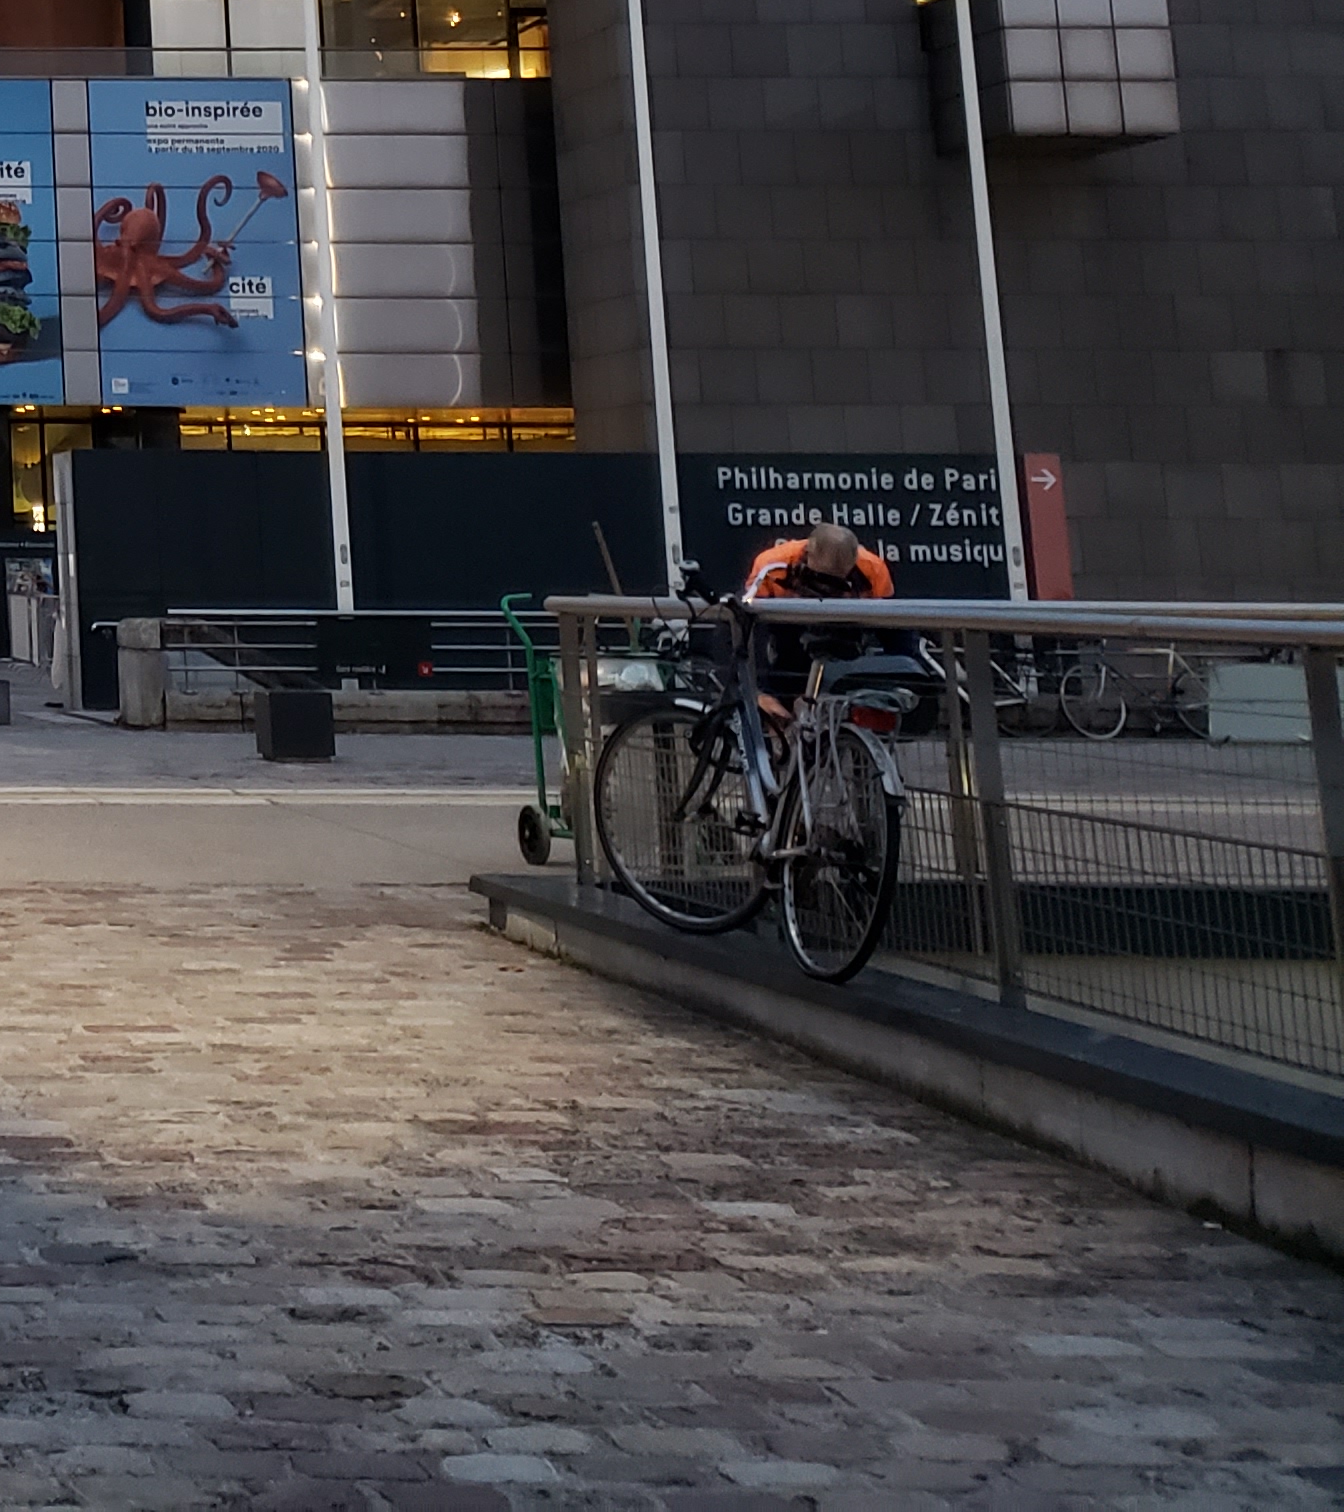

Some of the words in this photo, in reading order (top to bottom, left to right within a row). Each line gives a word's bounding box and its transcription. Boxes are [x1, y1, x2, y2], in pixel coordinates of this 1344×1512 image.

[145, 101, 264, 121] bio-inspirée
[146, 138, 169, 147] expo
[229, 275, 267, 294] cité
[716, 466, 894, 491] Philharmonie
[903, 467, 935, 491] de
[944, 467, 997, 492] Pari
[727, 502, 823, 527] Grande
[832, 501, 901, 527] Halle
[910, 502, 921, 527] /
[928, 501, 1001, 527] Zénit
[877, 538, 900, 563] la
[909, 538, 1005, 569] musiqu
